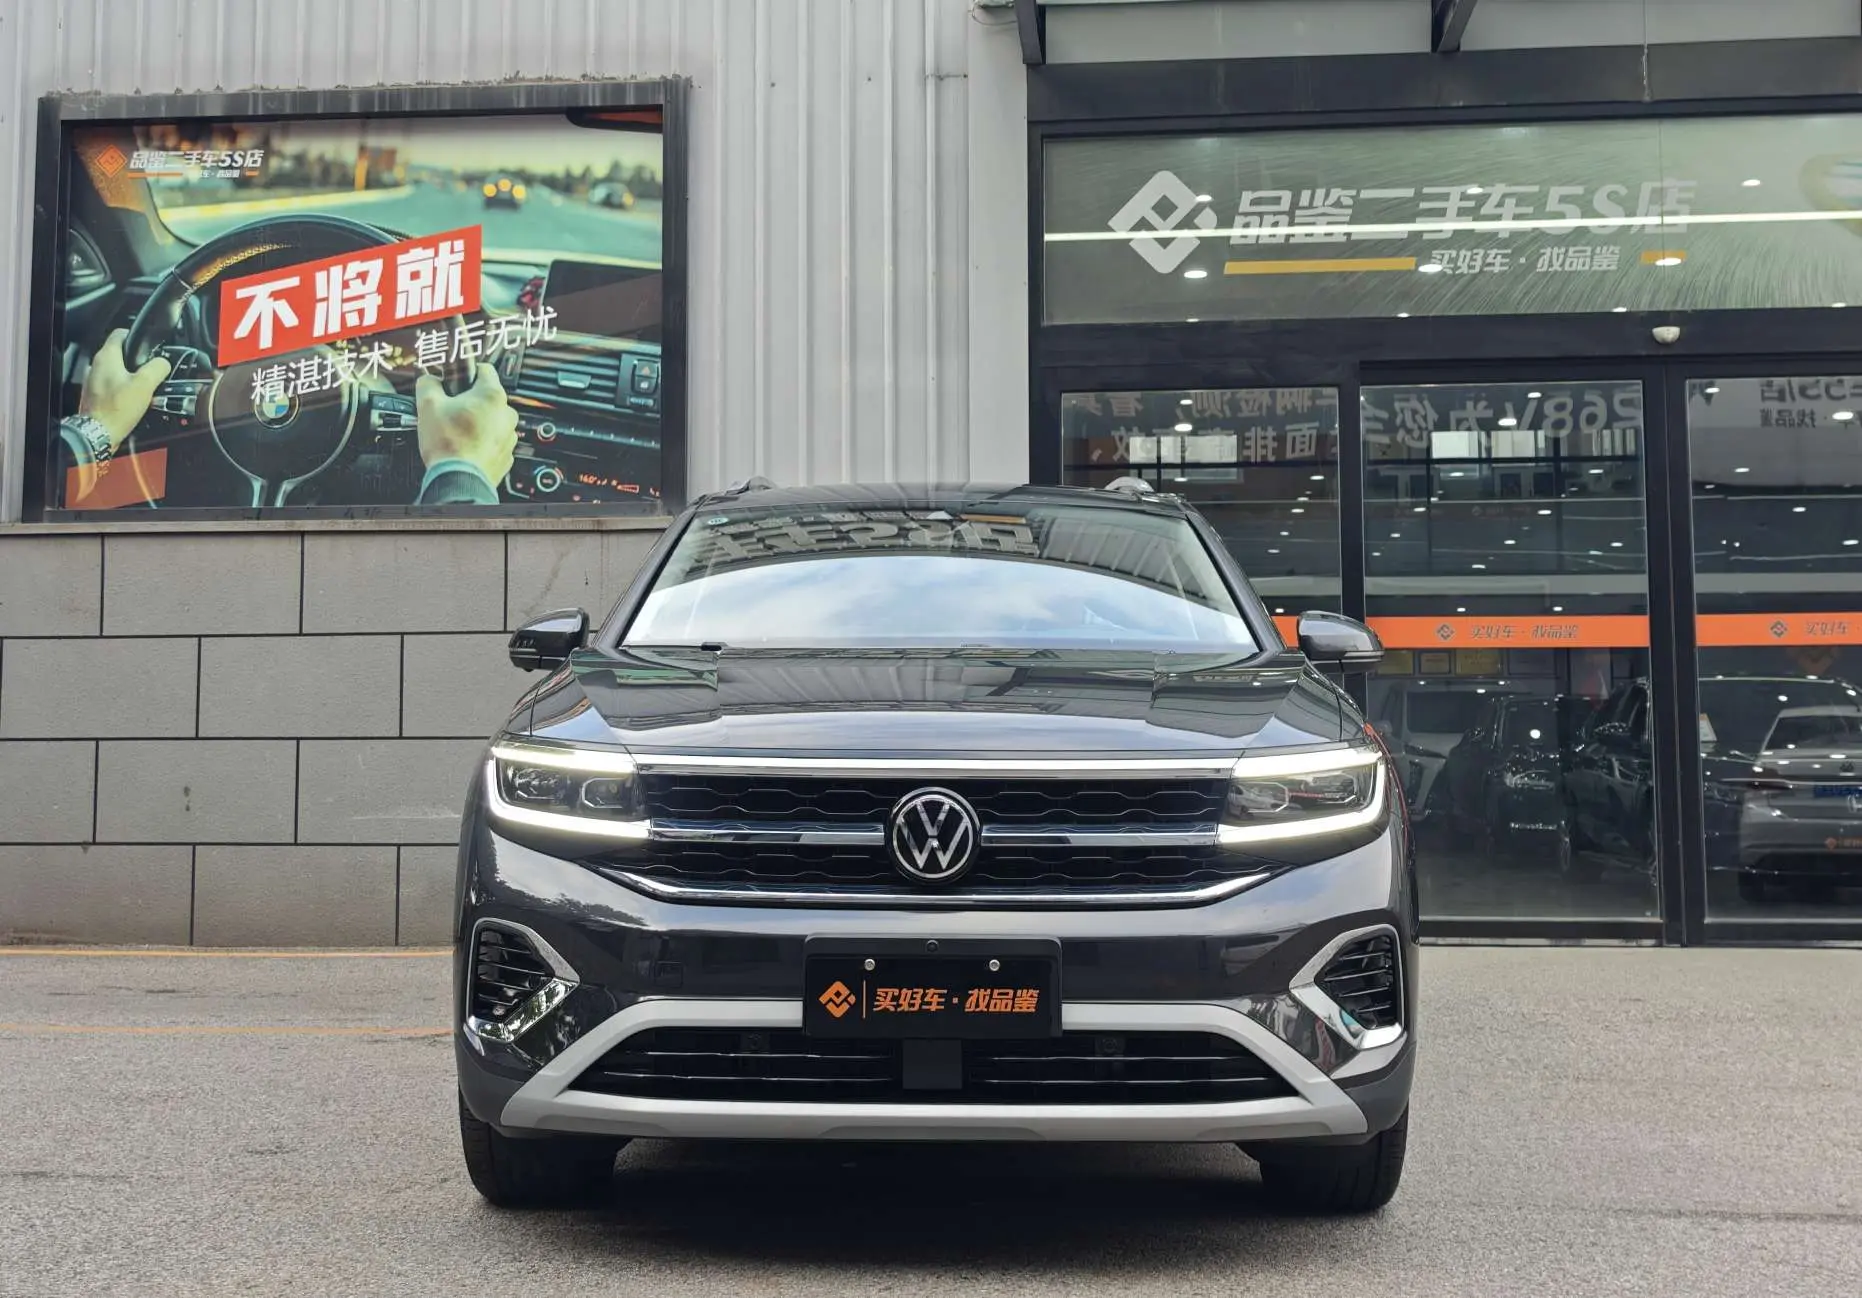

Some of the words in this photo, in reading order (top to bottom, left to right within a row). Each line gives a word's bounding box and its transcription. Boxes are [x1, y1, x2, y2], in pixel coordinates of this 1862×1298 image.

[1229, 178, 1698, 246] 品鉴二手车5S店
[233, 239, 465, 350] 不将就
[250, 341, 394, 405] 精湛技术
[414, 306, 558, 369] 售后无忧
